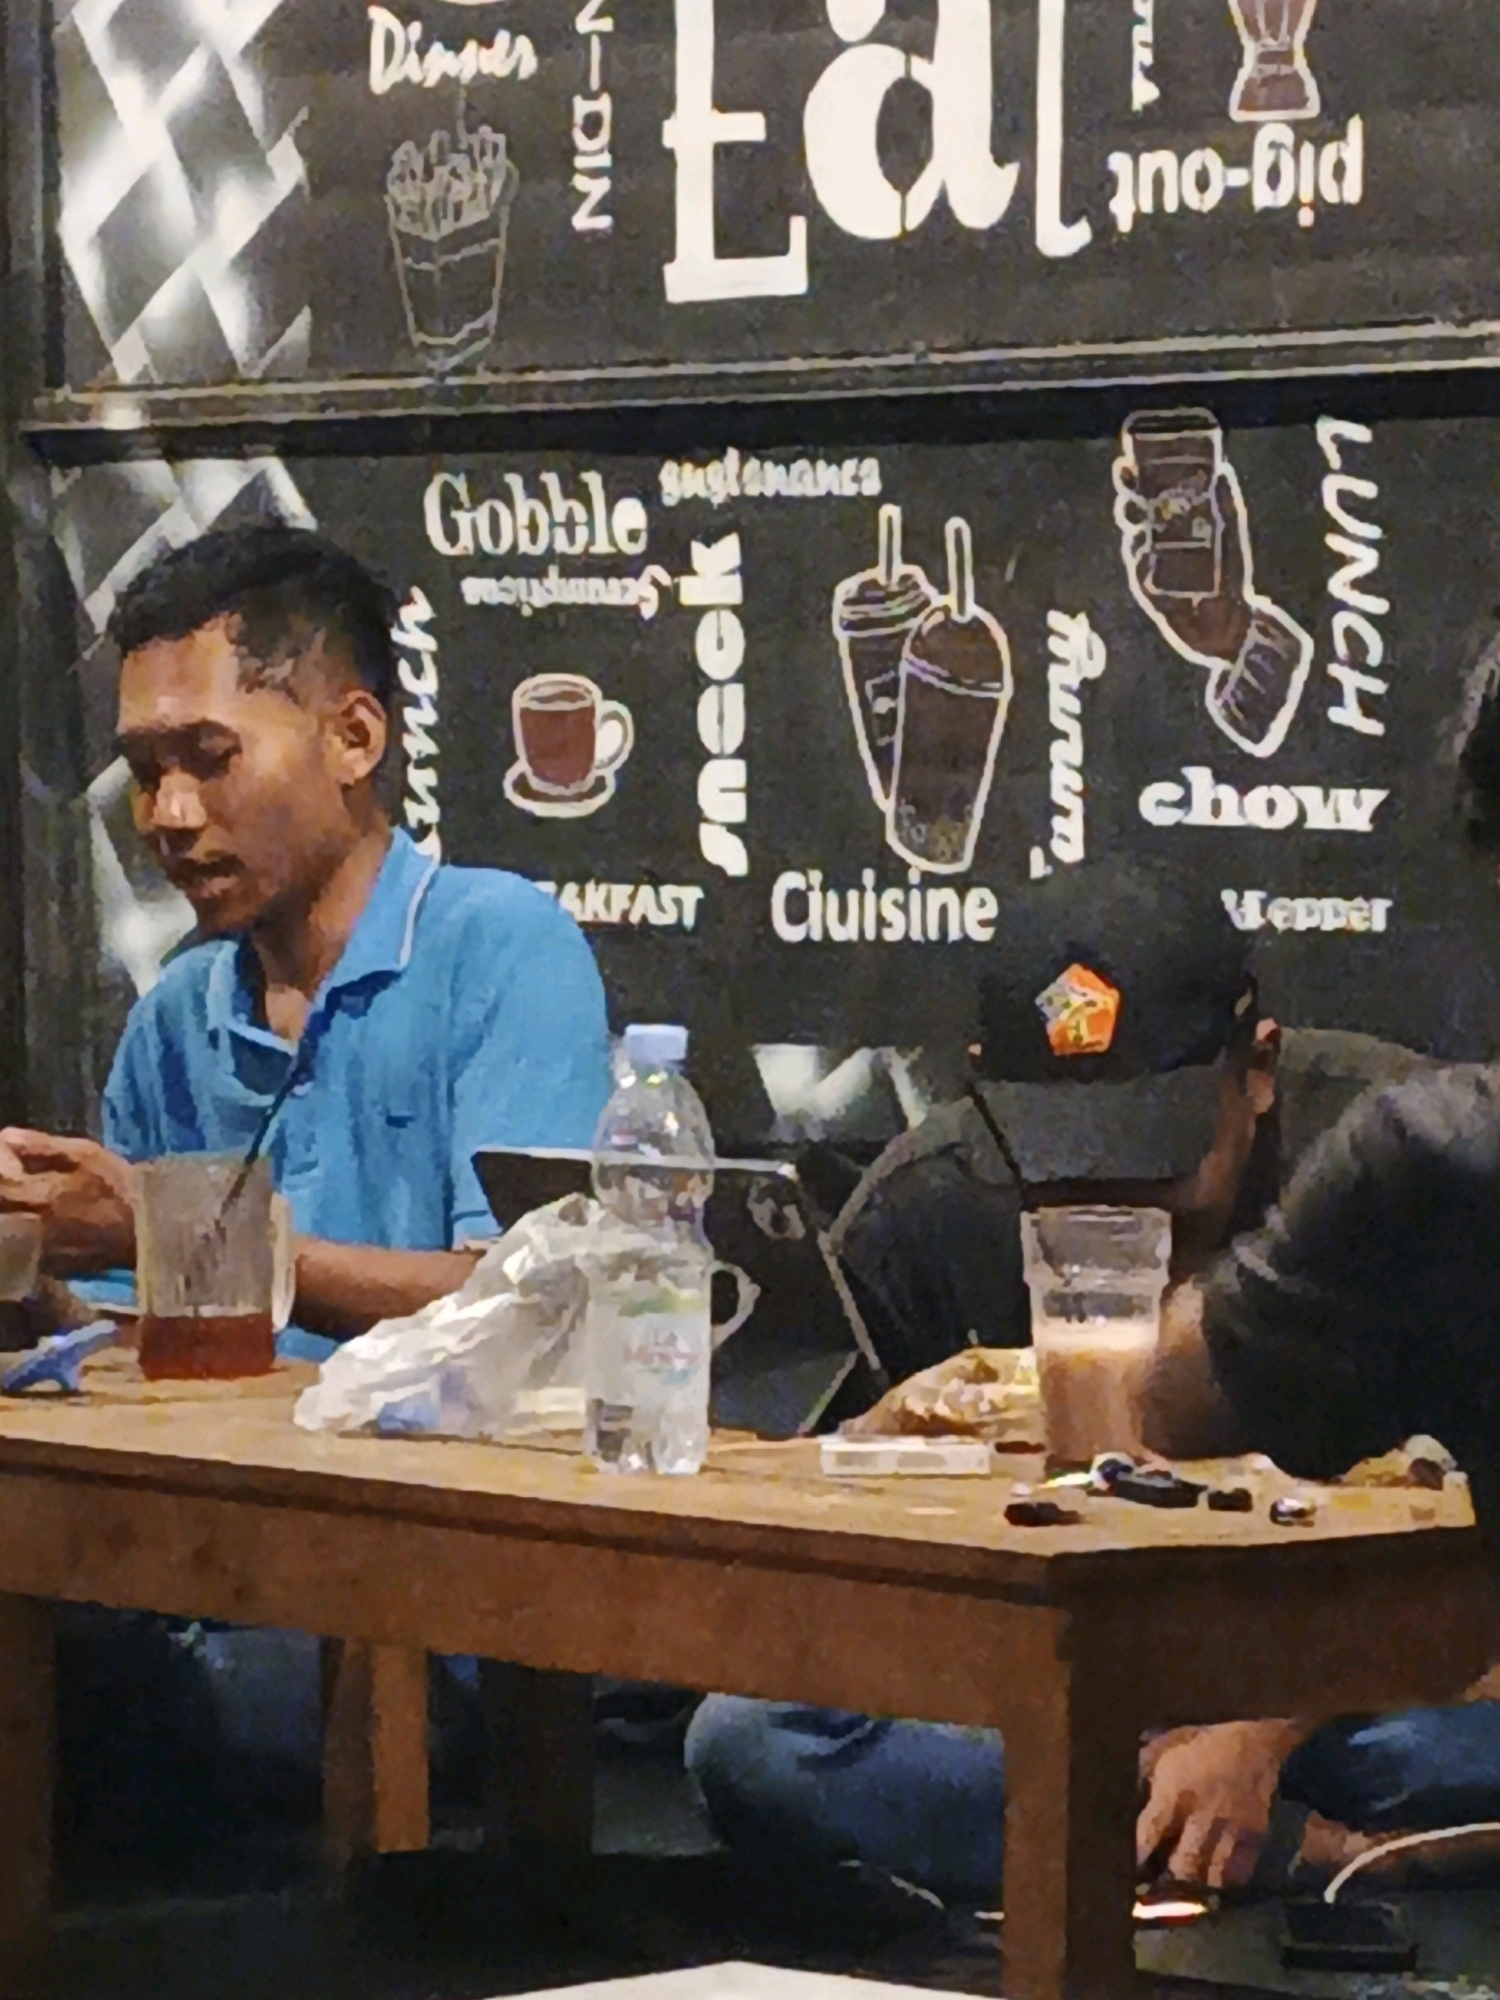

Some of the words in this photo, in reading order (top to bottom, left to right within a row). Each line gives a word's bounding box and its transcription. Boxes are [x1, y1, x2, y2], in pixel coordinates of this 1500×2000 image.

[1108, 113, 1363, 233] pig-out
[424, 471, 647, 555] Gobble
[1316, 416, 1389, 736] LUNCH
[388, 586, 441, 858] unch
[1030, 610, 1106, 878] ummy
[1139, 766, 1388, 831] chow
[536, 880, 704, 932] AKFAST
